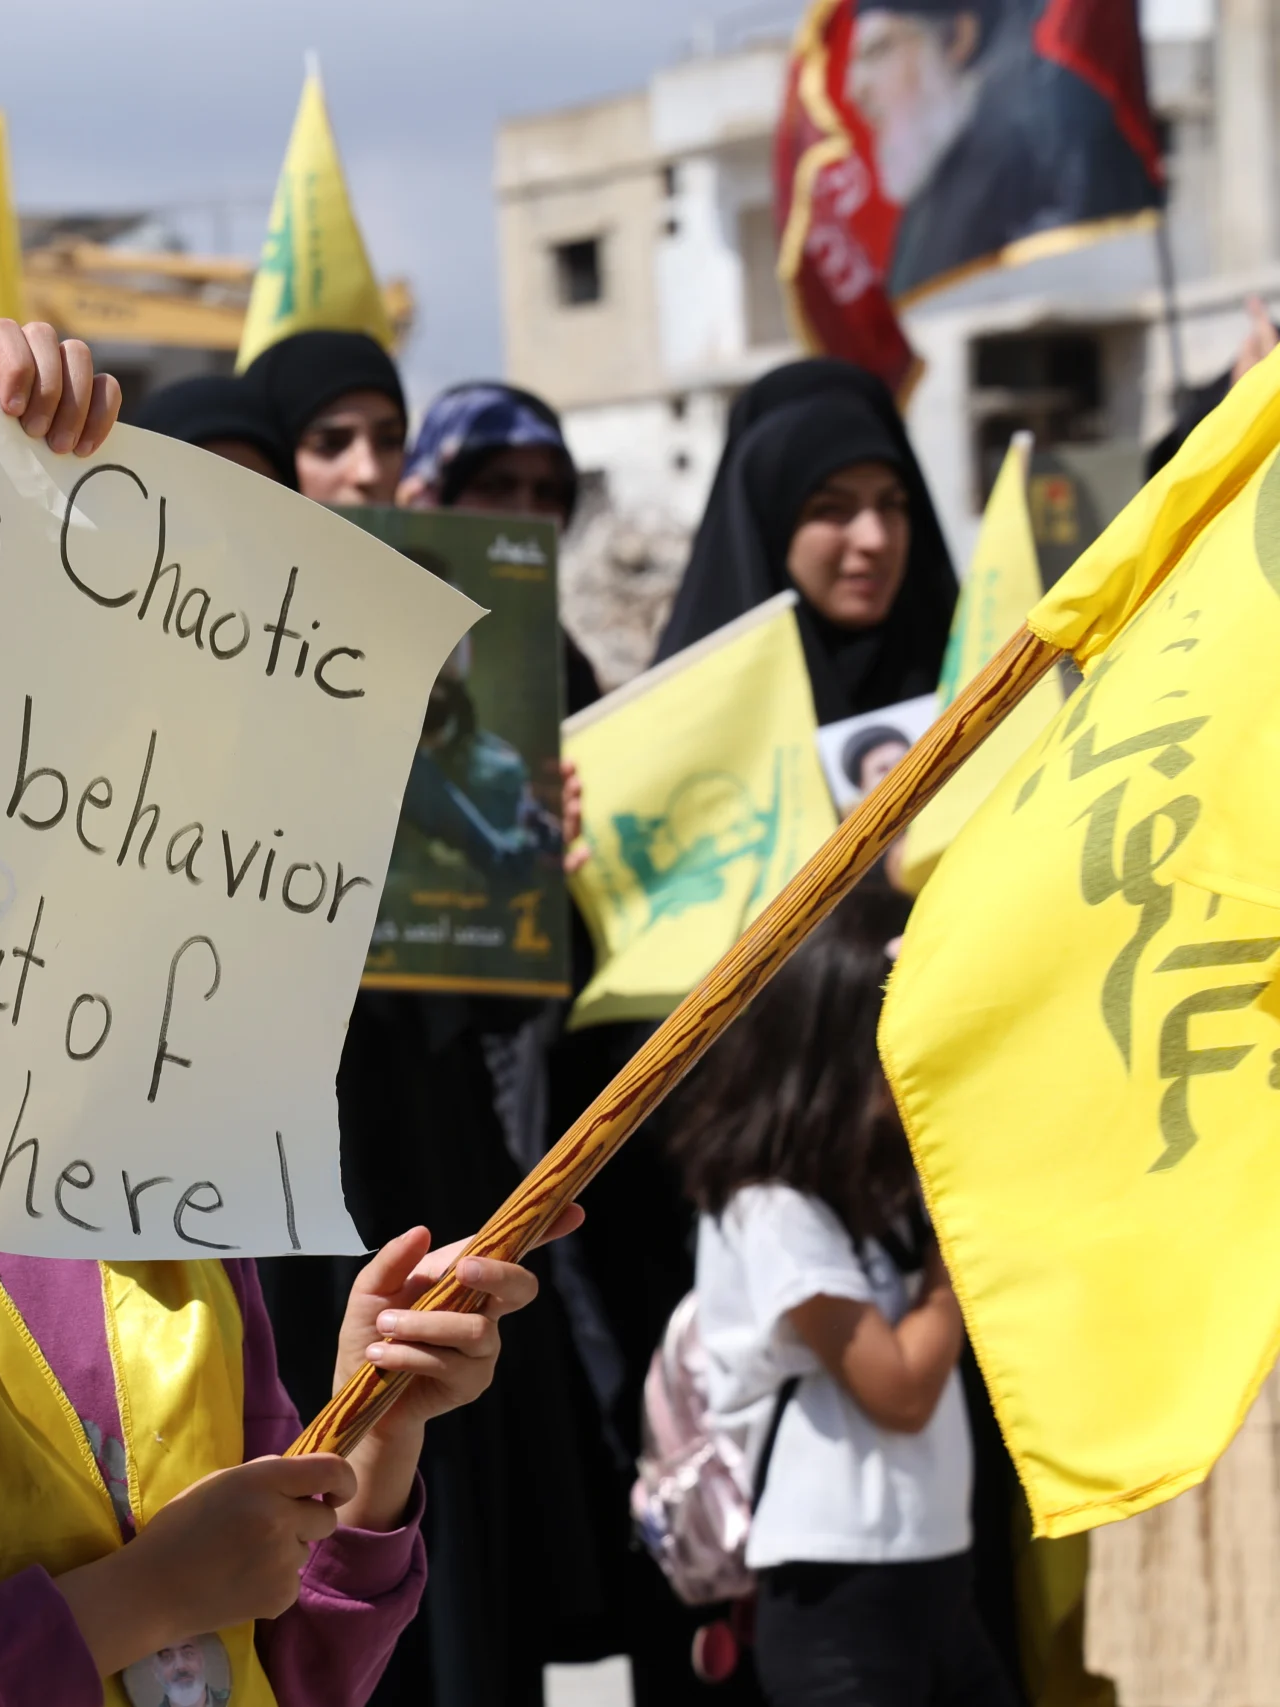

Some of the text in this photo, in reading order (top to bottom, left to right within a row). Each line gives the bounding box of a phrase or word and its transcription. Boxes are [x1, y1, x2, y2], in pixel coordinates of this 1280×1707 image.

[59, 462, 367, 700] Chaotic
[6, 692, 374, 924] behavior
[64, 933, 223, 1104] of
